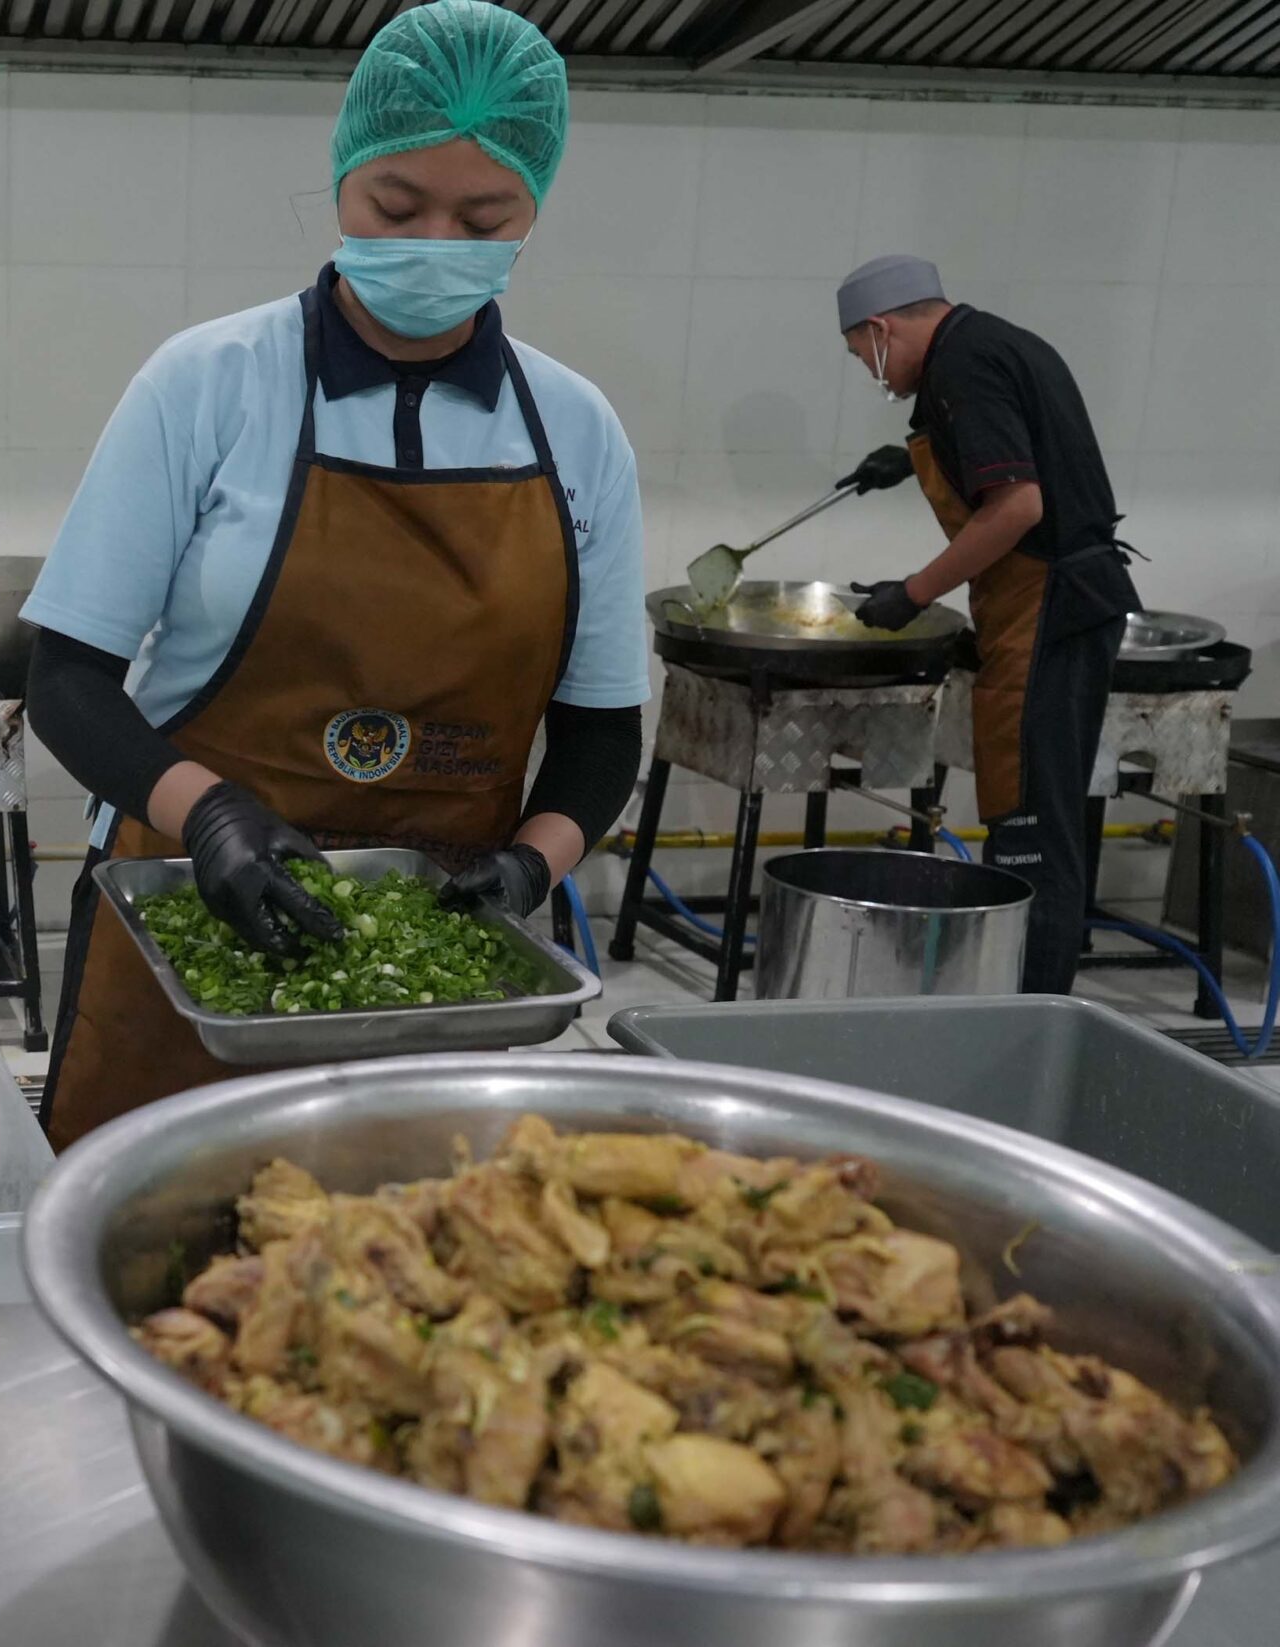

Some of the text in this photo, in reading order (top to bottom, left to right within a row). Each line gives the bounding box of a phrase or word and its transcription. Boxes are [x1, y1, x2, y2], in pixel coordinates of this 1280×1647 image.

[327, 741, 403, 780] REPUBLIK INDONESIA
[420, 740, 459, 758] GIZI
